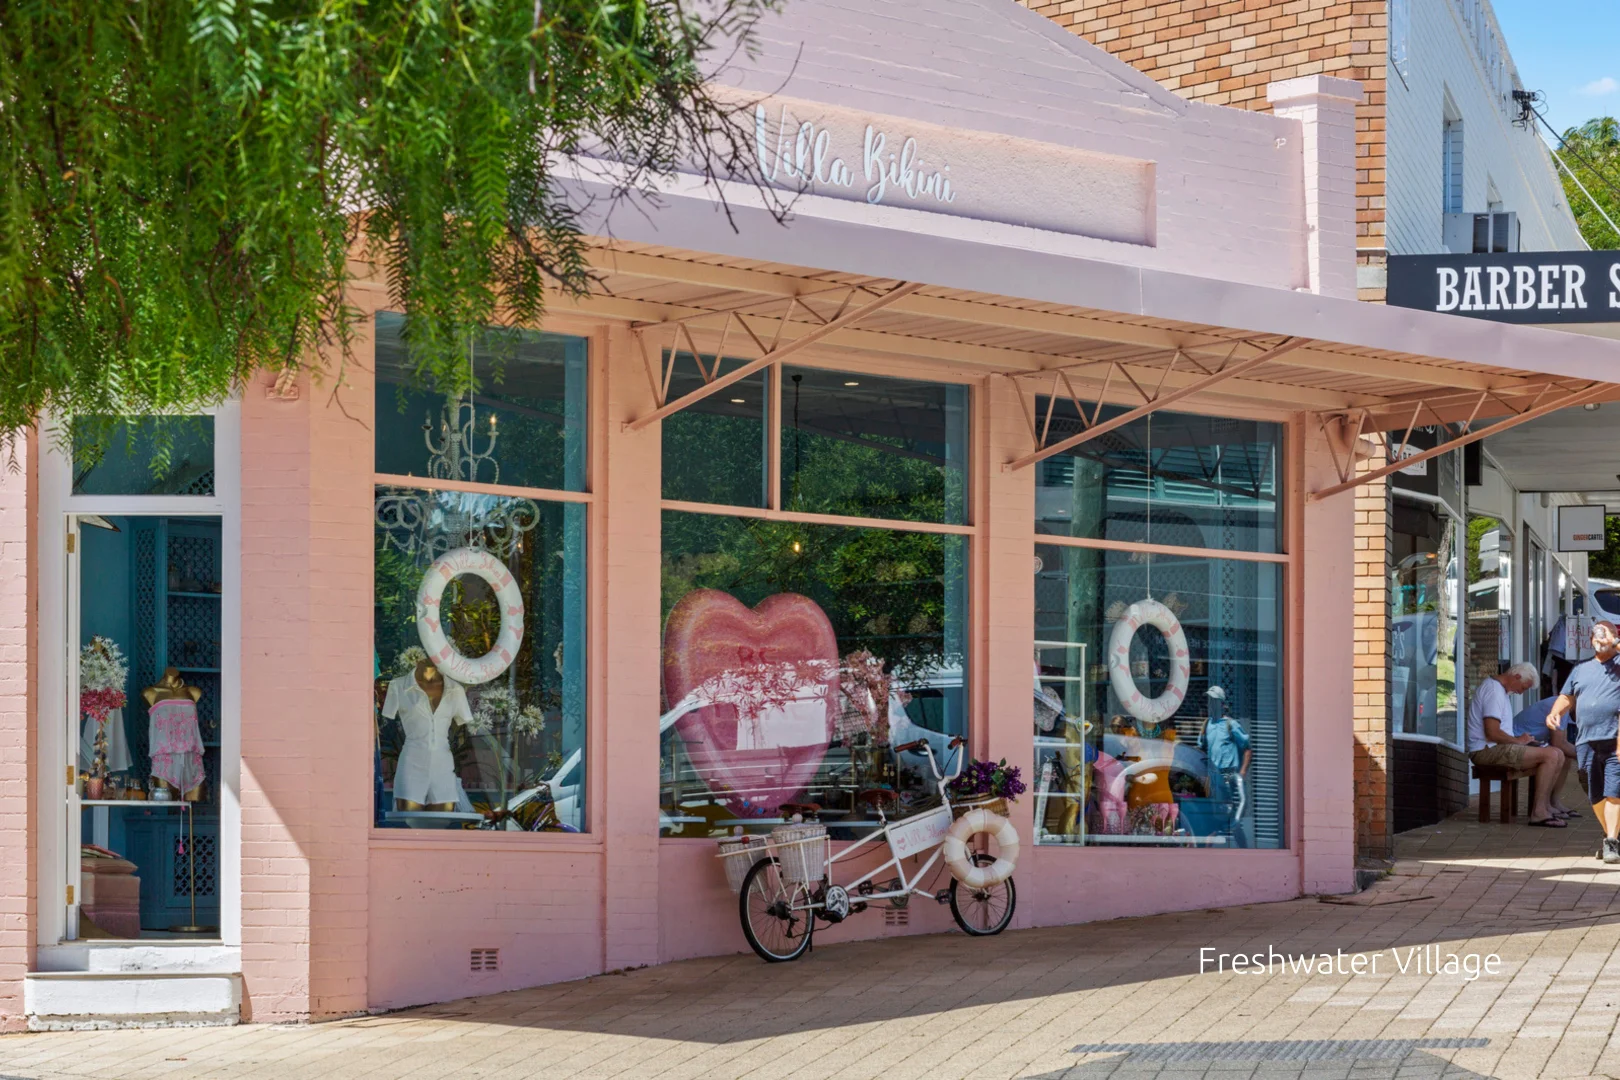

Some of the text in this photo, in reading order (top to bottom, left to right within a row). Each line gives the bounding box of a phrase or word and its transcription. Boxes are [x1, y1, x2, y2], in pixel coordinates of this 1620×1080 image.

[755, 103, 956, 204] Villa Bikini
[1436, 264, 1588, 311] BARBER
